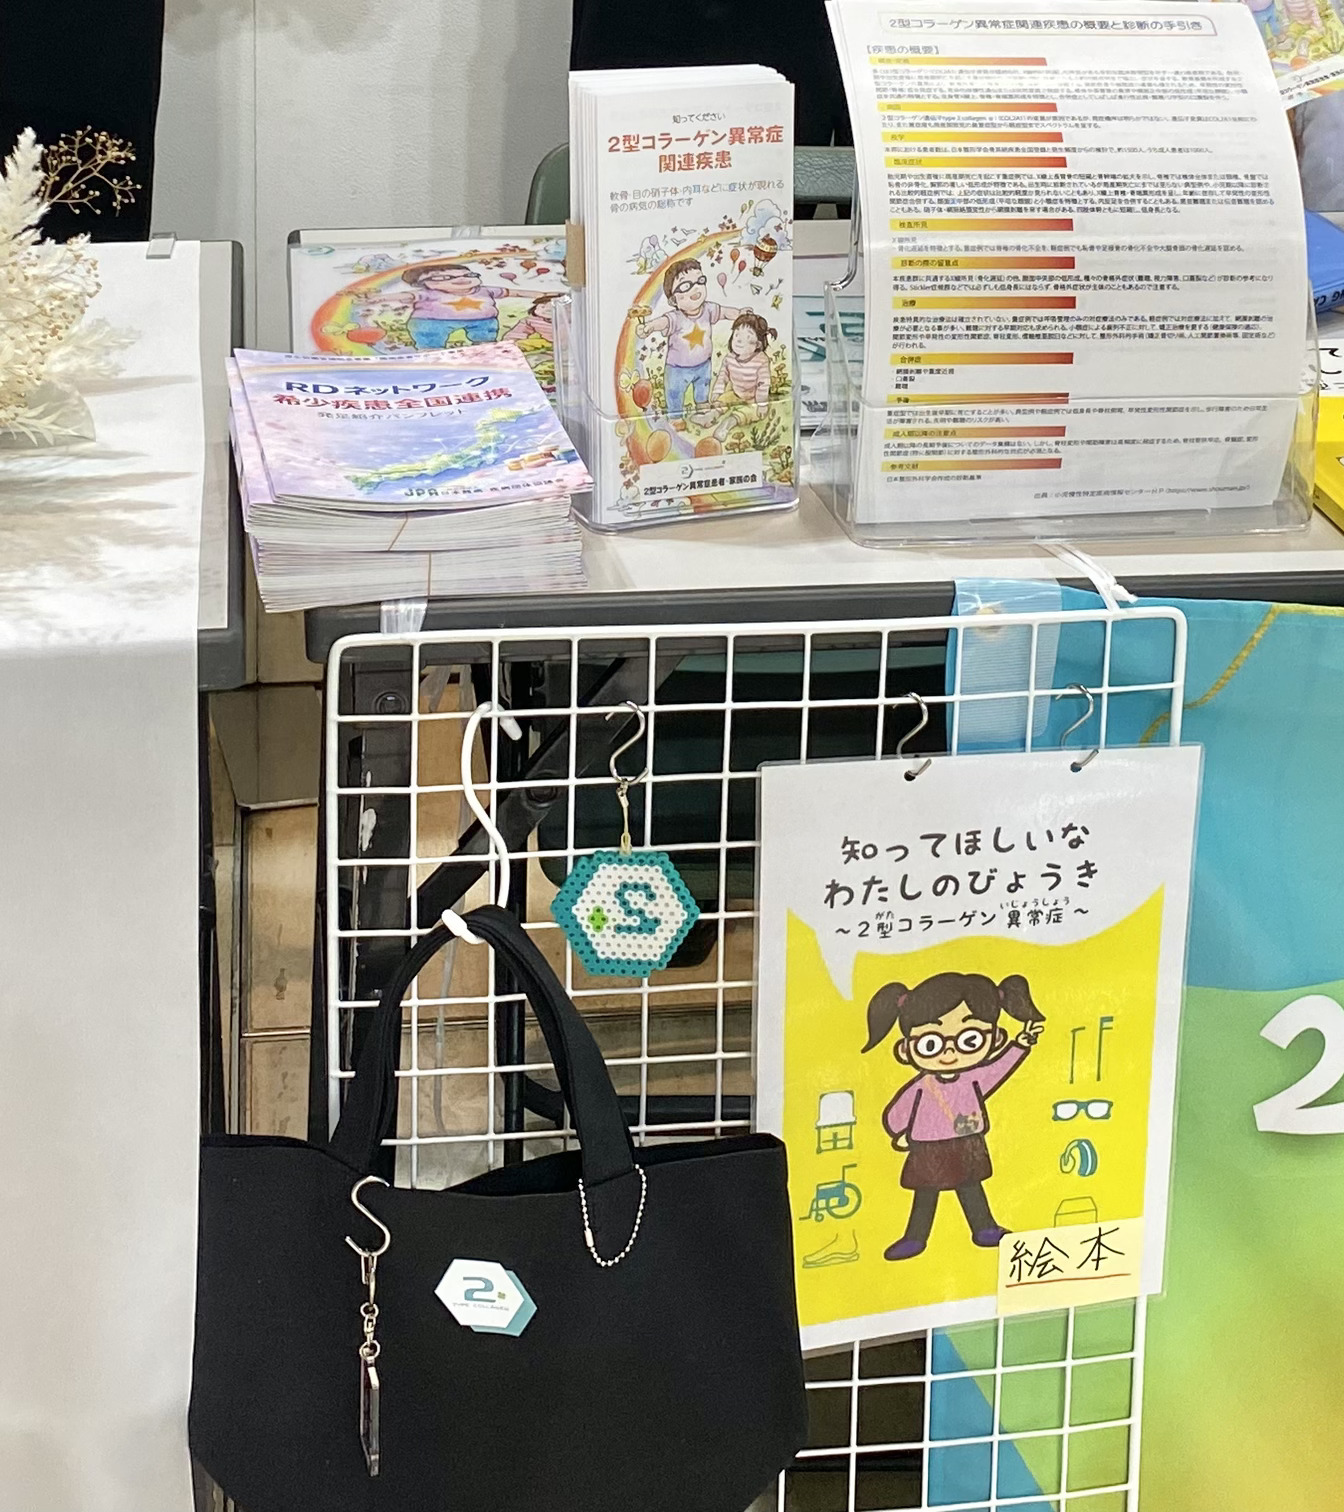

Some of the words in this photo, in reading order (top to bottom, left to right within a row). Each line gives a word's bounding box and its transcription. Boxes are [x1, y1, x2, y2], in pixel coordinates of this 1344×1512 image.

[608, 124, 785, 153] 2型コラーゲン異常症
[658, 150, 733, 173] 関連疾患
[285, 375, 490, 396] RDネットワーク
[841, 823, 1090, 865] 知ってほしいな
[824, 859, 1098, 909] わたしのびょうき
[1009, 1225, 1124, 1279] 絵本
